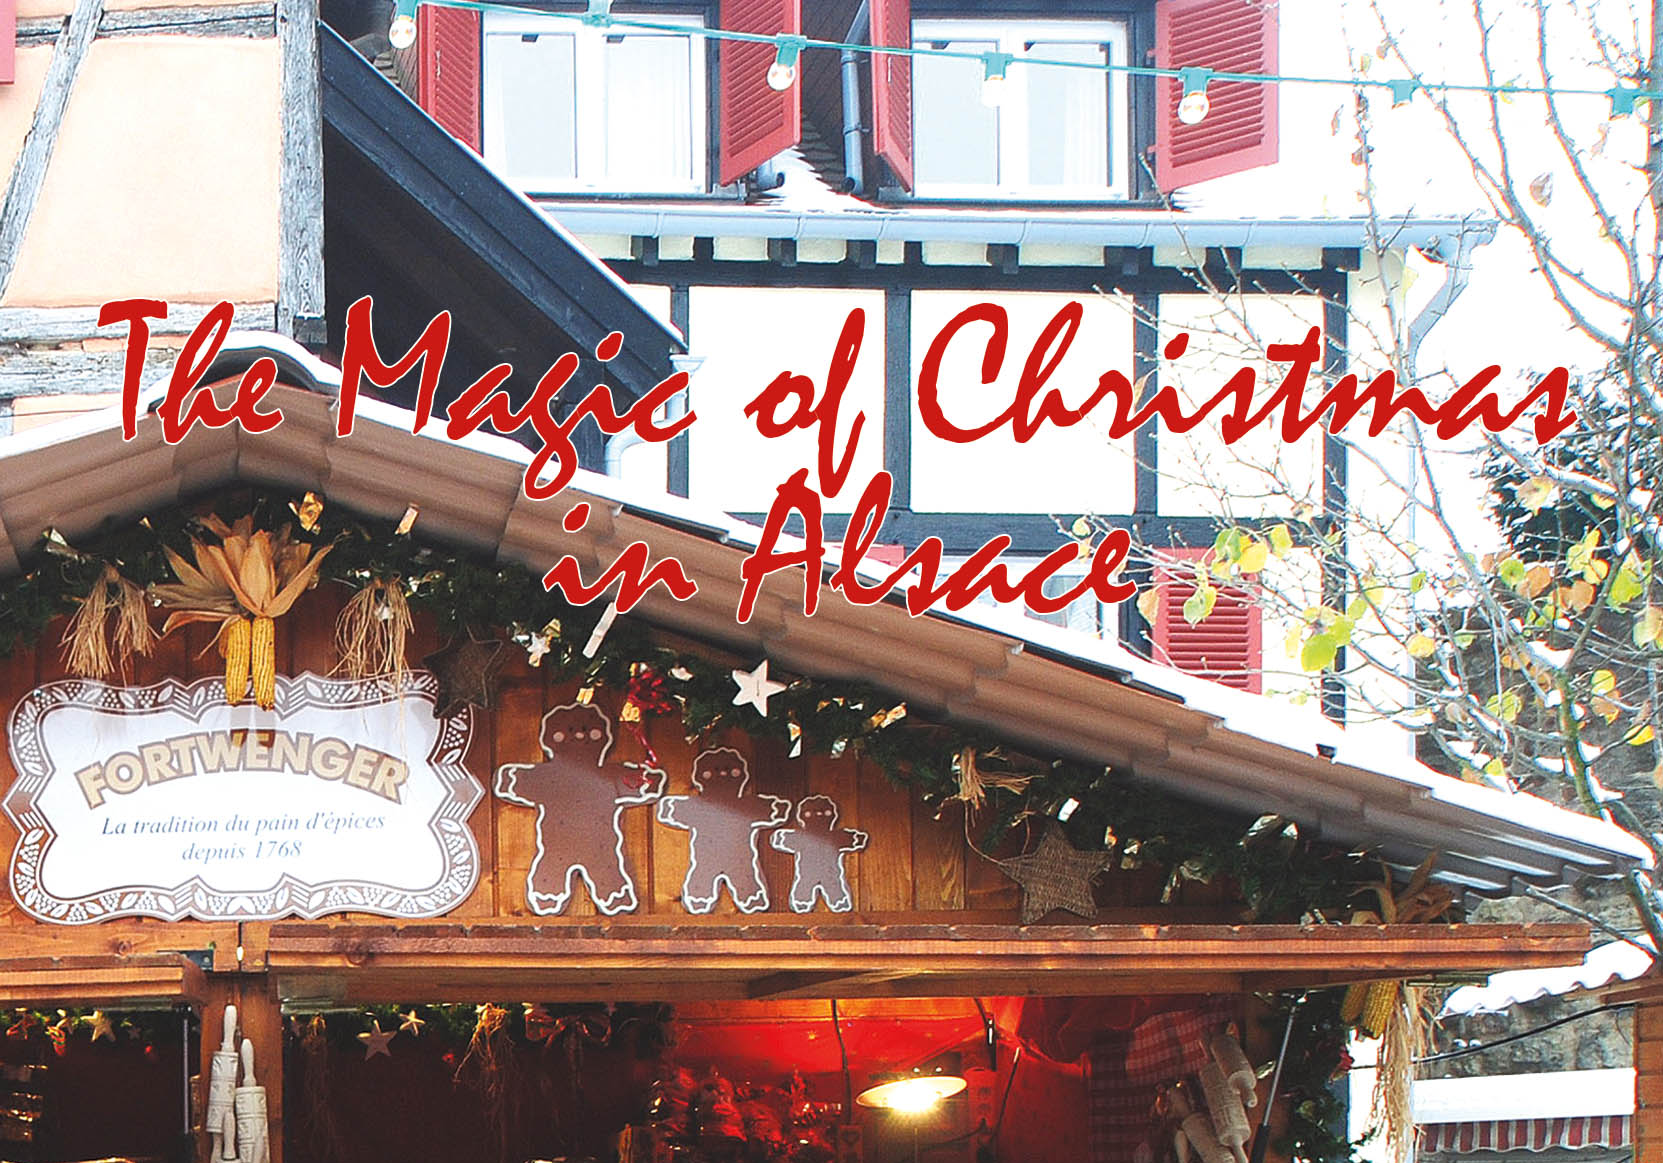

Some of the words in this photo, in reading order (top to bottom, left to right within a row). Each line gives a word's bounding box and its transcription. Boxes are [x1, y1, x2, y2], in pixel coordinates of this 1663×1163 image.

[74, 728, 410, 810] FORTWENGER
[102, 817, 127, 835] La
[132, 815, 219, 834] tradition
[225, 814, 250, 832] du
[255, 812, 300, 836] pain
[306, 811, 387, 834] d'épices
[182, 842, 246, 865] depuis
[255, 840, 304, 858] 1768
